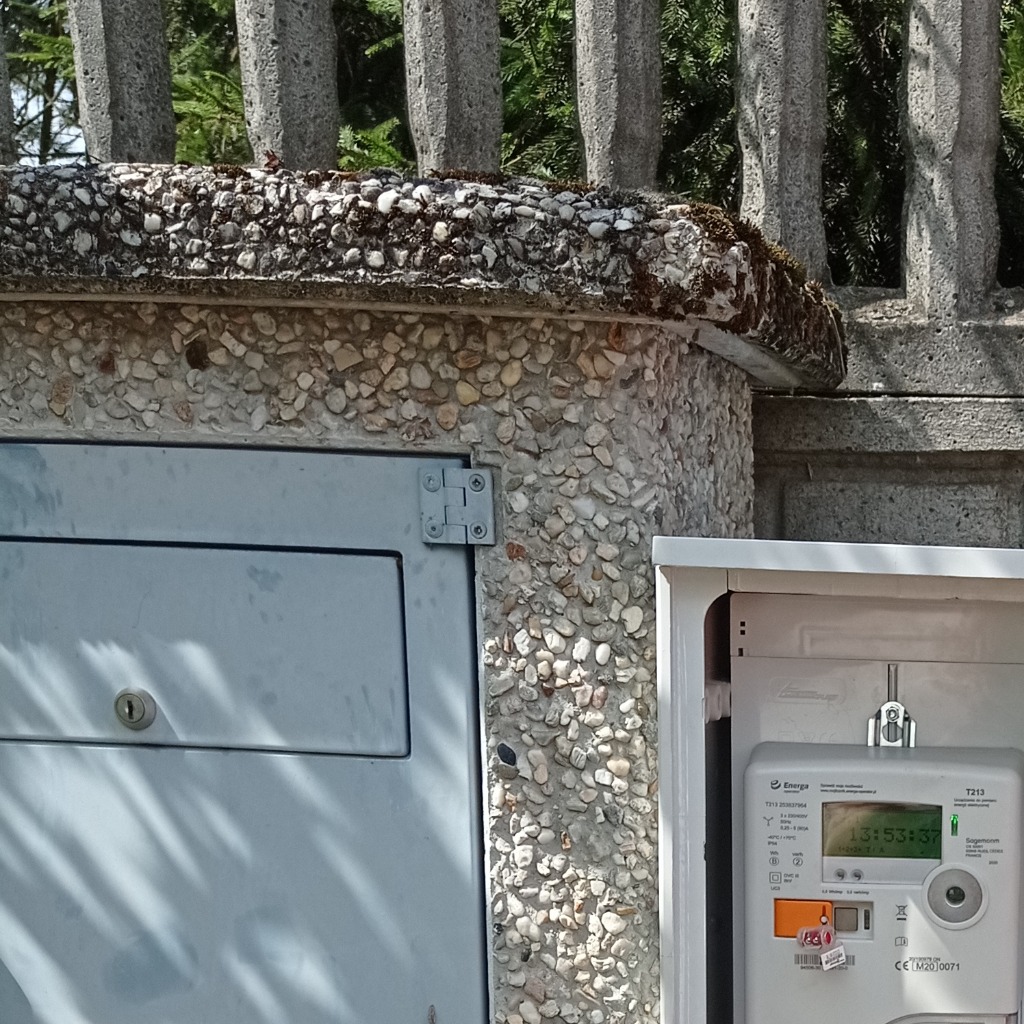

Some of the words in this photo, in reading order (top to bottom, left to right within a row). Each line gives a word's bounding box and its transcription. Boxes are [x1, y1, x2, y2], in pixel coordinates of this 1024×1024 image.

[783, 782, 809, 791] Energa
[966, 788, 985, 796] T213
[850, 827, 941, 844] 13:53:37
[916, 962, 935, 971] M20
[939, 962, 960, 971] 0071
